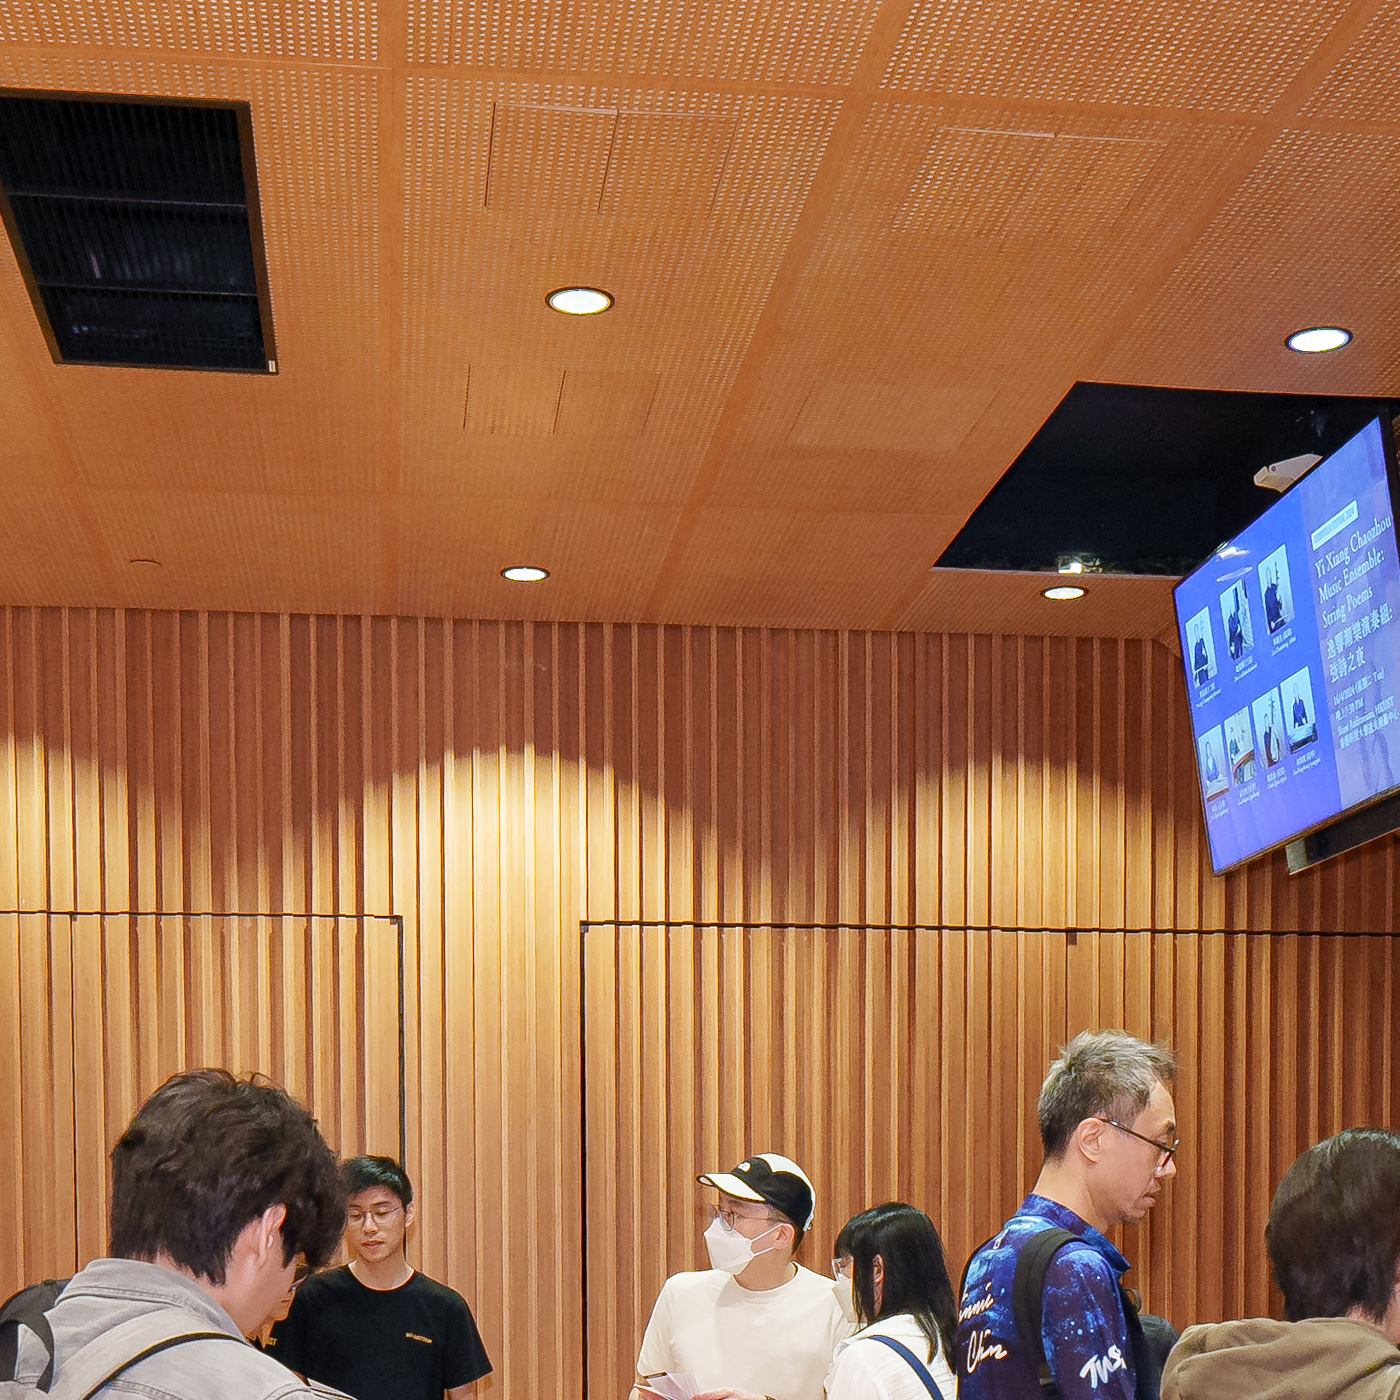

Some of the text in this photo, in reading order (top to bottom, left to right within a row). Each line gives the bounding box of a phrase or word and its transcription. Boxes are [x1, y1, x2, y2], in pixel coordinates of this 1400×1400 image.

[1314, 560, 1325, 579] Yi
[1325, 546, 1350, 573] Xiang
[1350, 514, 1392, 553] Chaozhou
[1318, 548, 1385, 605] Music Ensemble:
[1322, 586, 1373, 629] String Poems
